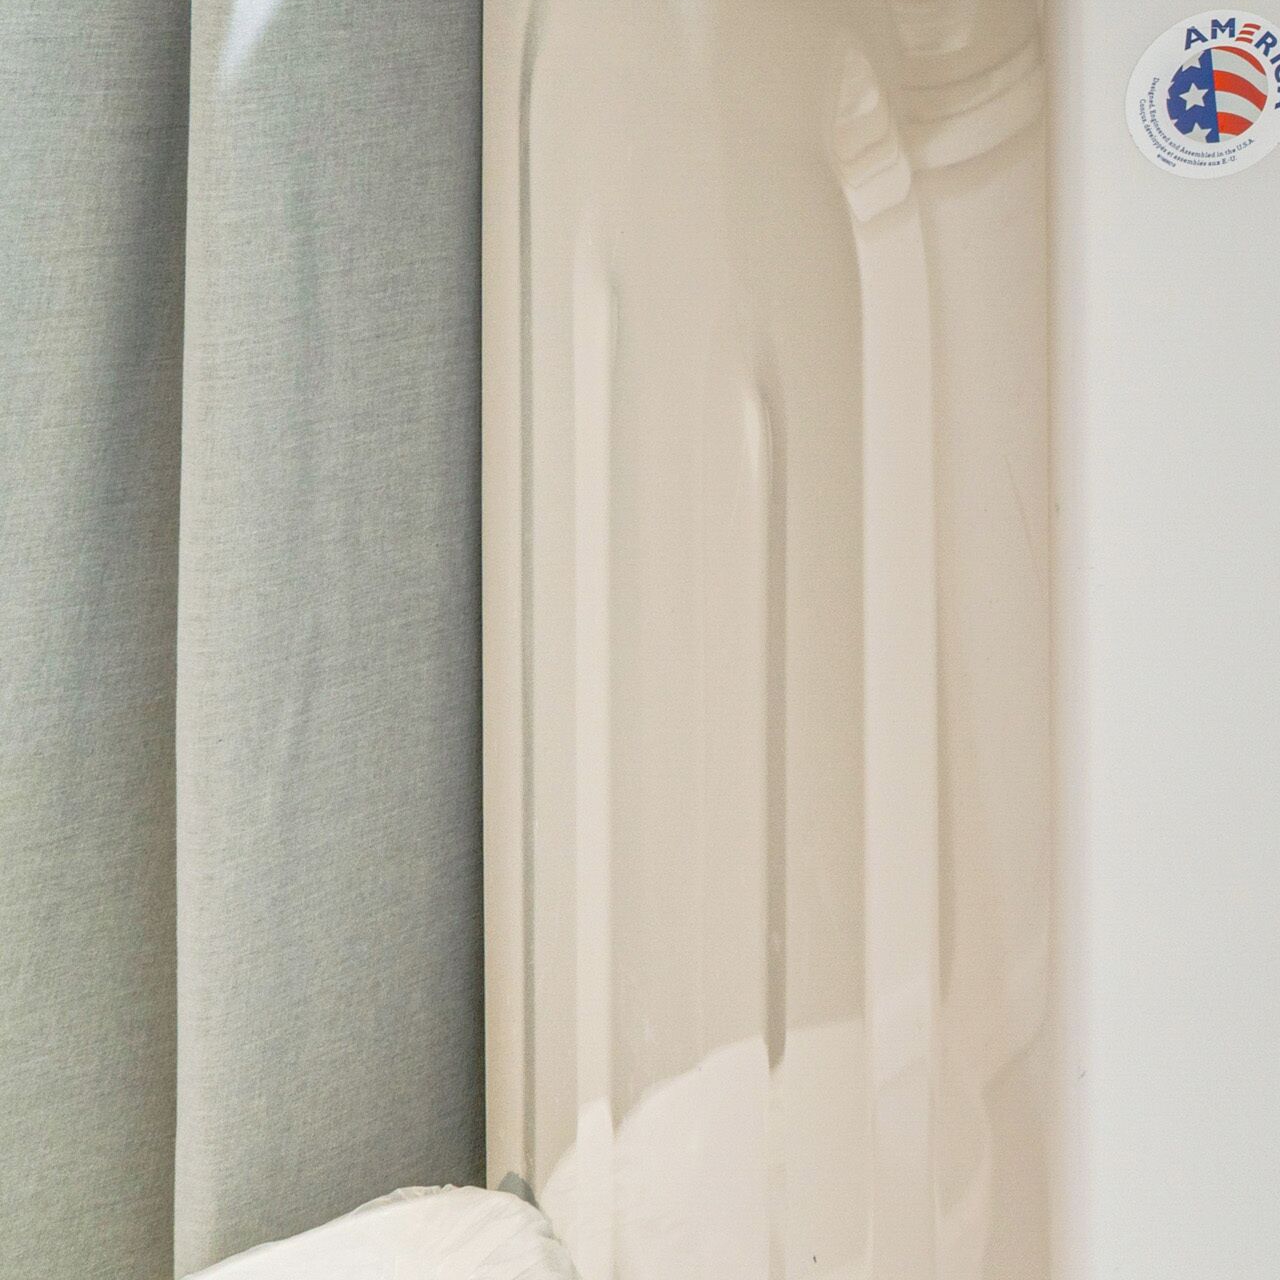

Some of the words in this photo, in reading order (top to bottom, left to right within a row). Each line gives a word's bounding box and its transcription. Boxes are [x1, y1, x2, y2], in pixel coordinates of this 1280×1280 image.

[1150, 109, 1171, 142] Engineered
[1169, 140, 1180, 151] and
[1180, 146, 1216, 158] Assembled
